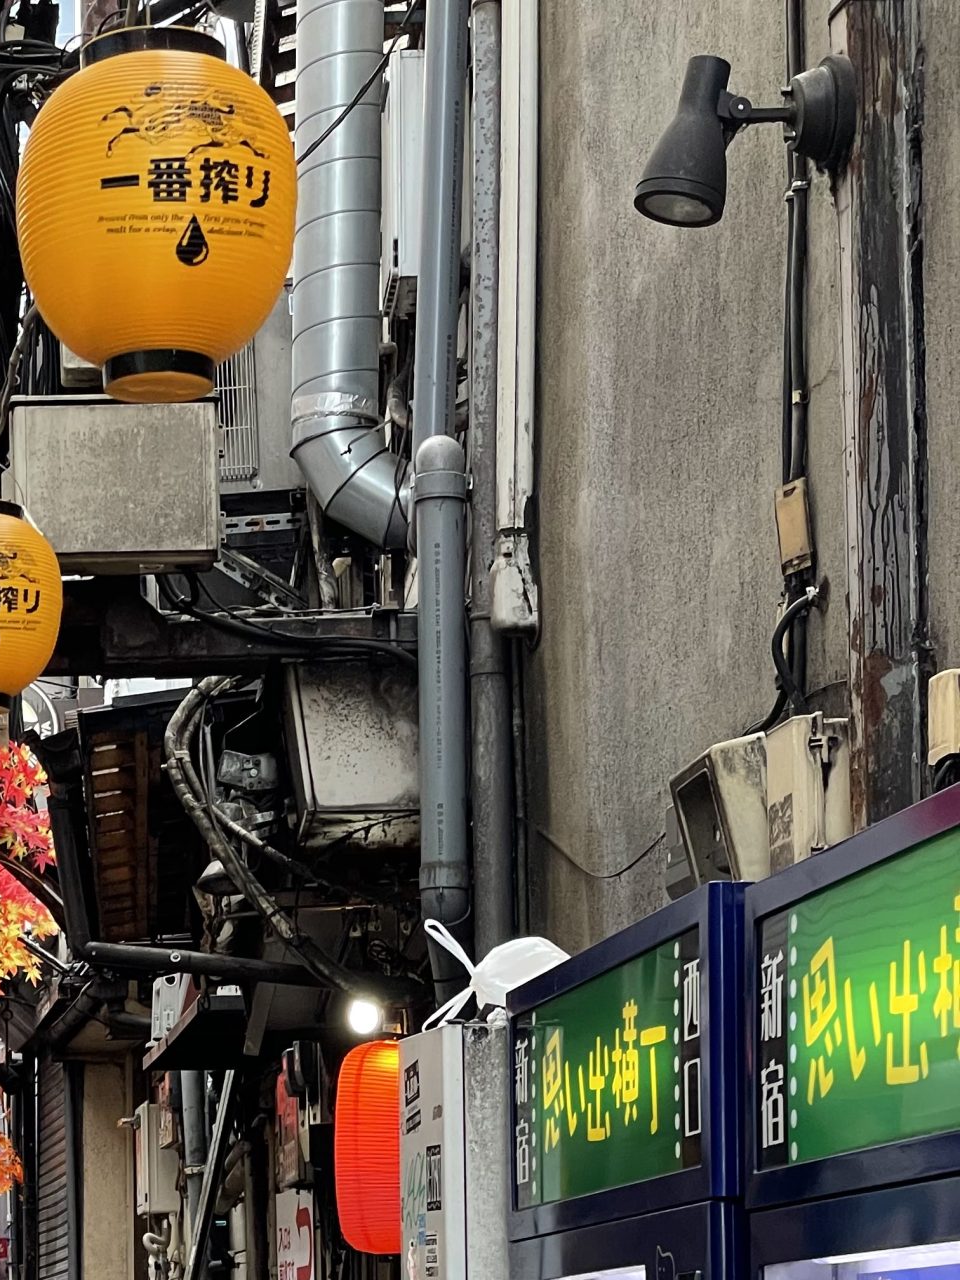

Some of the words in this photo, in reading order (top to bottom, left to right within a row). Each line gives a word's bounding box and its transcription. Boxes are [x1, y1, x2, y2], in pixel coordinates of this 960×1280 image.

[100, 157, 271, 208] 一番搾り
[514, 1038, 530, 1185] 新宿
[542, 999, 667, 1154] 思い出横丁
[682, 958, 703, 1138] 西口
[761, 948, 785, 1149] 新宿
